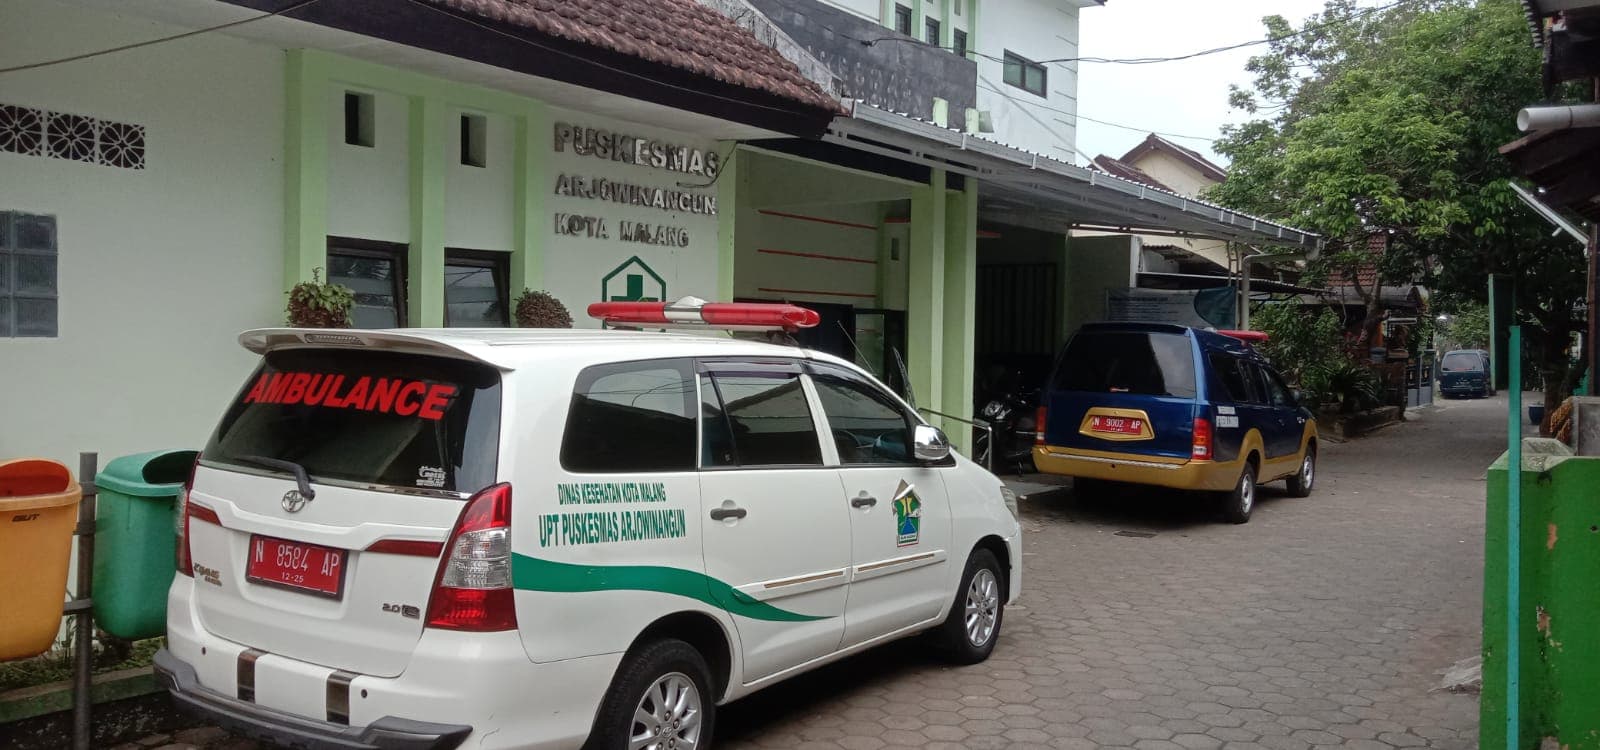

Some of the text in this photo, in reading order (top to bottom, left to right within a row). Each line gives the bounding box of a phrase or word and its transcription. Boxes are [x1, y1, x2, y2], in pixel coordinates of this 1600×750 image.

[553, 121, 719, 177] PUSKESMAS
[554, 212, 690, 248] KOTA MALANG
[244, 372, 456, 420] AMBULANCE
[1094, 417, 1100, 426] N
[1131, 420, 1141, 430] AP
[557, 482, 667, 505] DINAS KESEHATAN KOTA MALANG
[538, 508, 687, 548] UPT PUSKESMAS ARJOWINANGUN
[255, 540, 340, 577] N 8584 AP
[281, 571, 304, 583] 12-25
